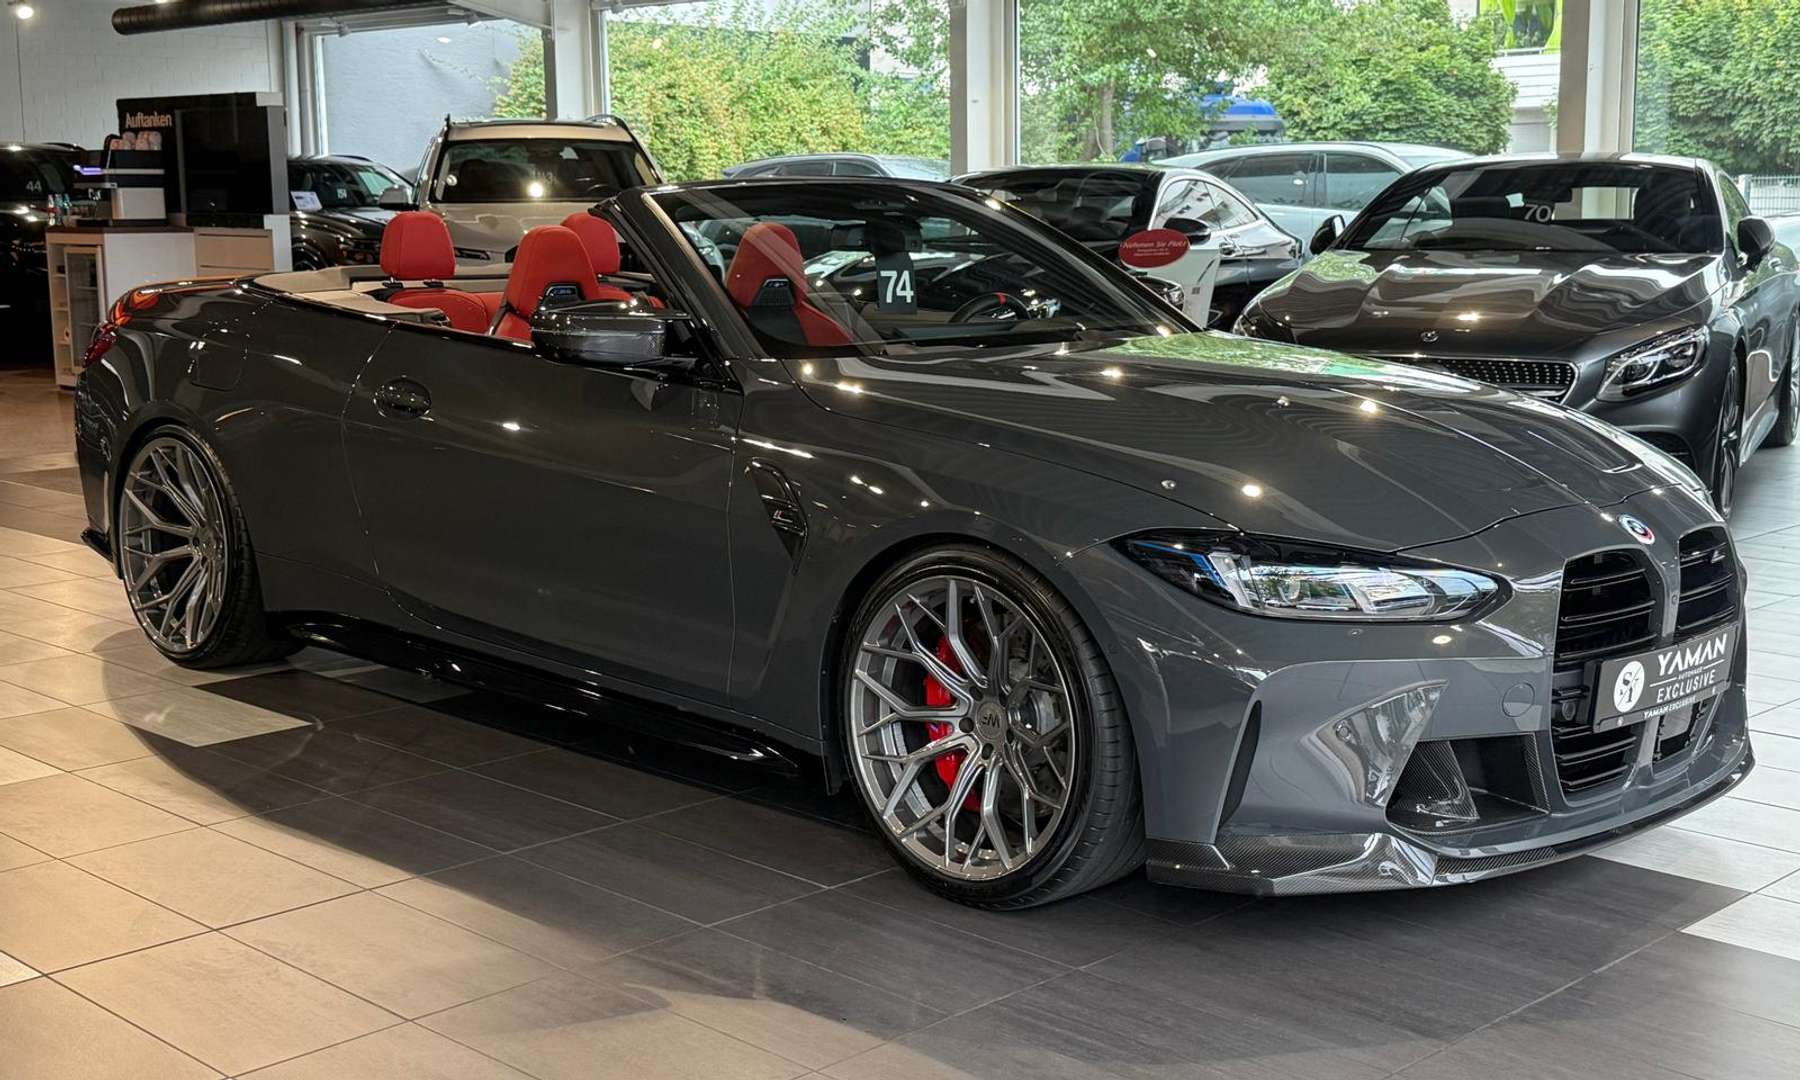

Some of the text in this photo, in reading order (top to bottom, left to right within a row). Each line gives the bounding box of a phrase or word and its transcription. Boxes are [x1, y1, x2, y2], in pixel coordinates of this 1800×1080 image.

[125, 111, 172, 129] Auftanken
[1524, 203, 1551, 222] 70
[880, 270, 914, 303] 74
[1658, 633, 1727, 676] YAMAN
[1656, 669, 1716, 703] EXCLUSIVE
